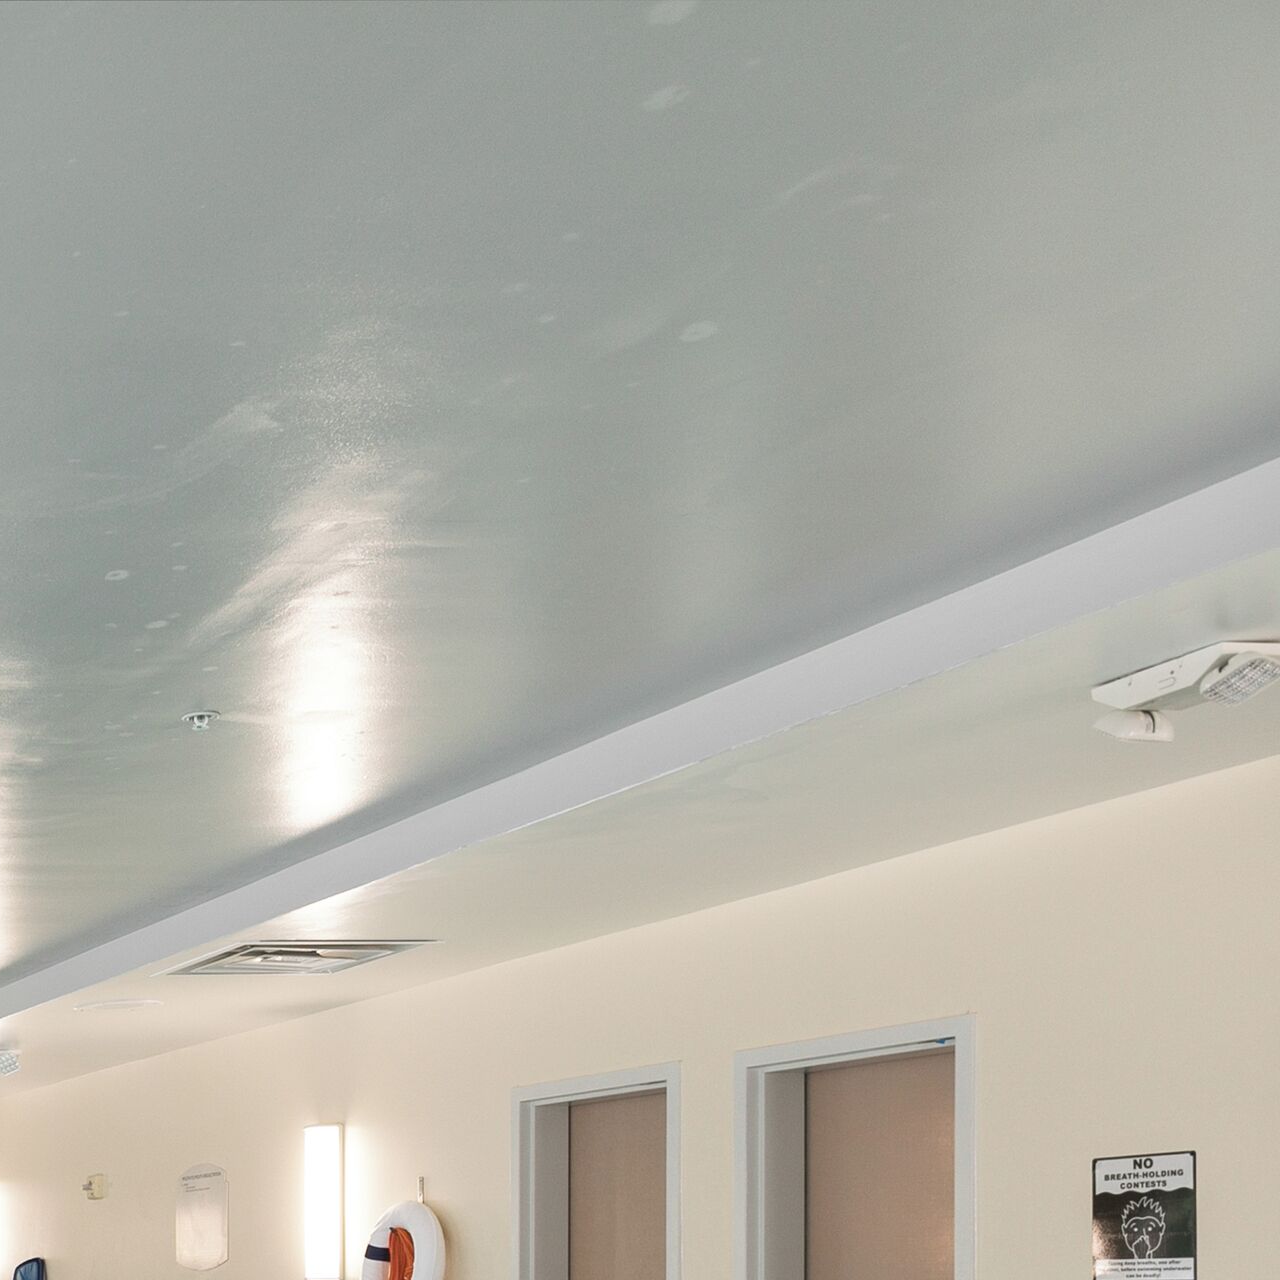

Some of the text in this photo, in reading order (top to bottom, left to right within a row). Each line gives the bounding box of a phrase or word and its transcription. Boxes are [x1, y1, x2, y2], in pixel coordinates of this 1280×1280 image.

[1132, 1158, 1154, 1170] NO
[1104, 1169, 1184, 1182] BREATH-HOLDING
[1120, 1180, 1167, 1190] CONTESTS
